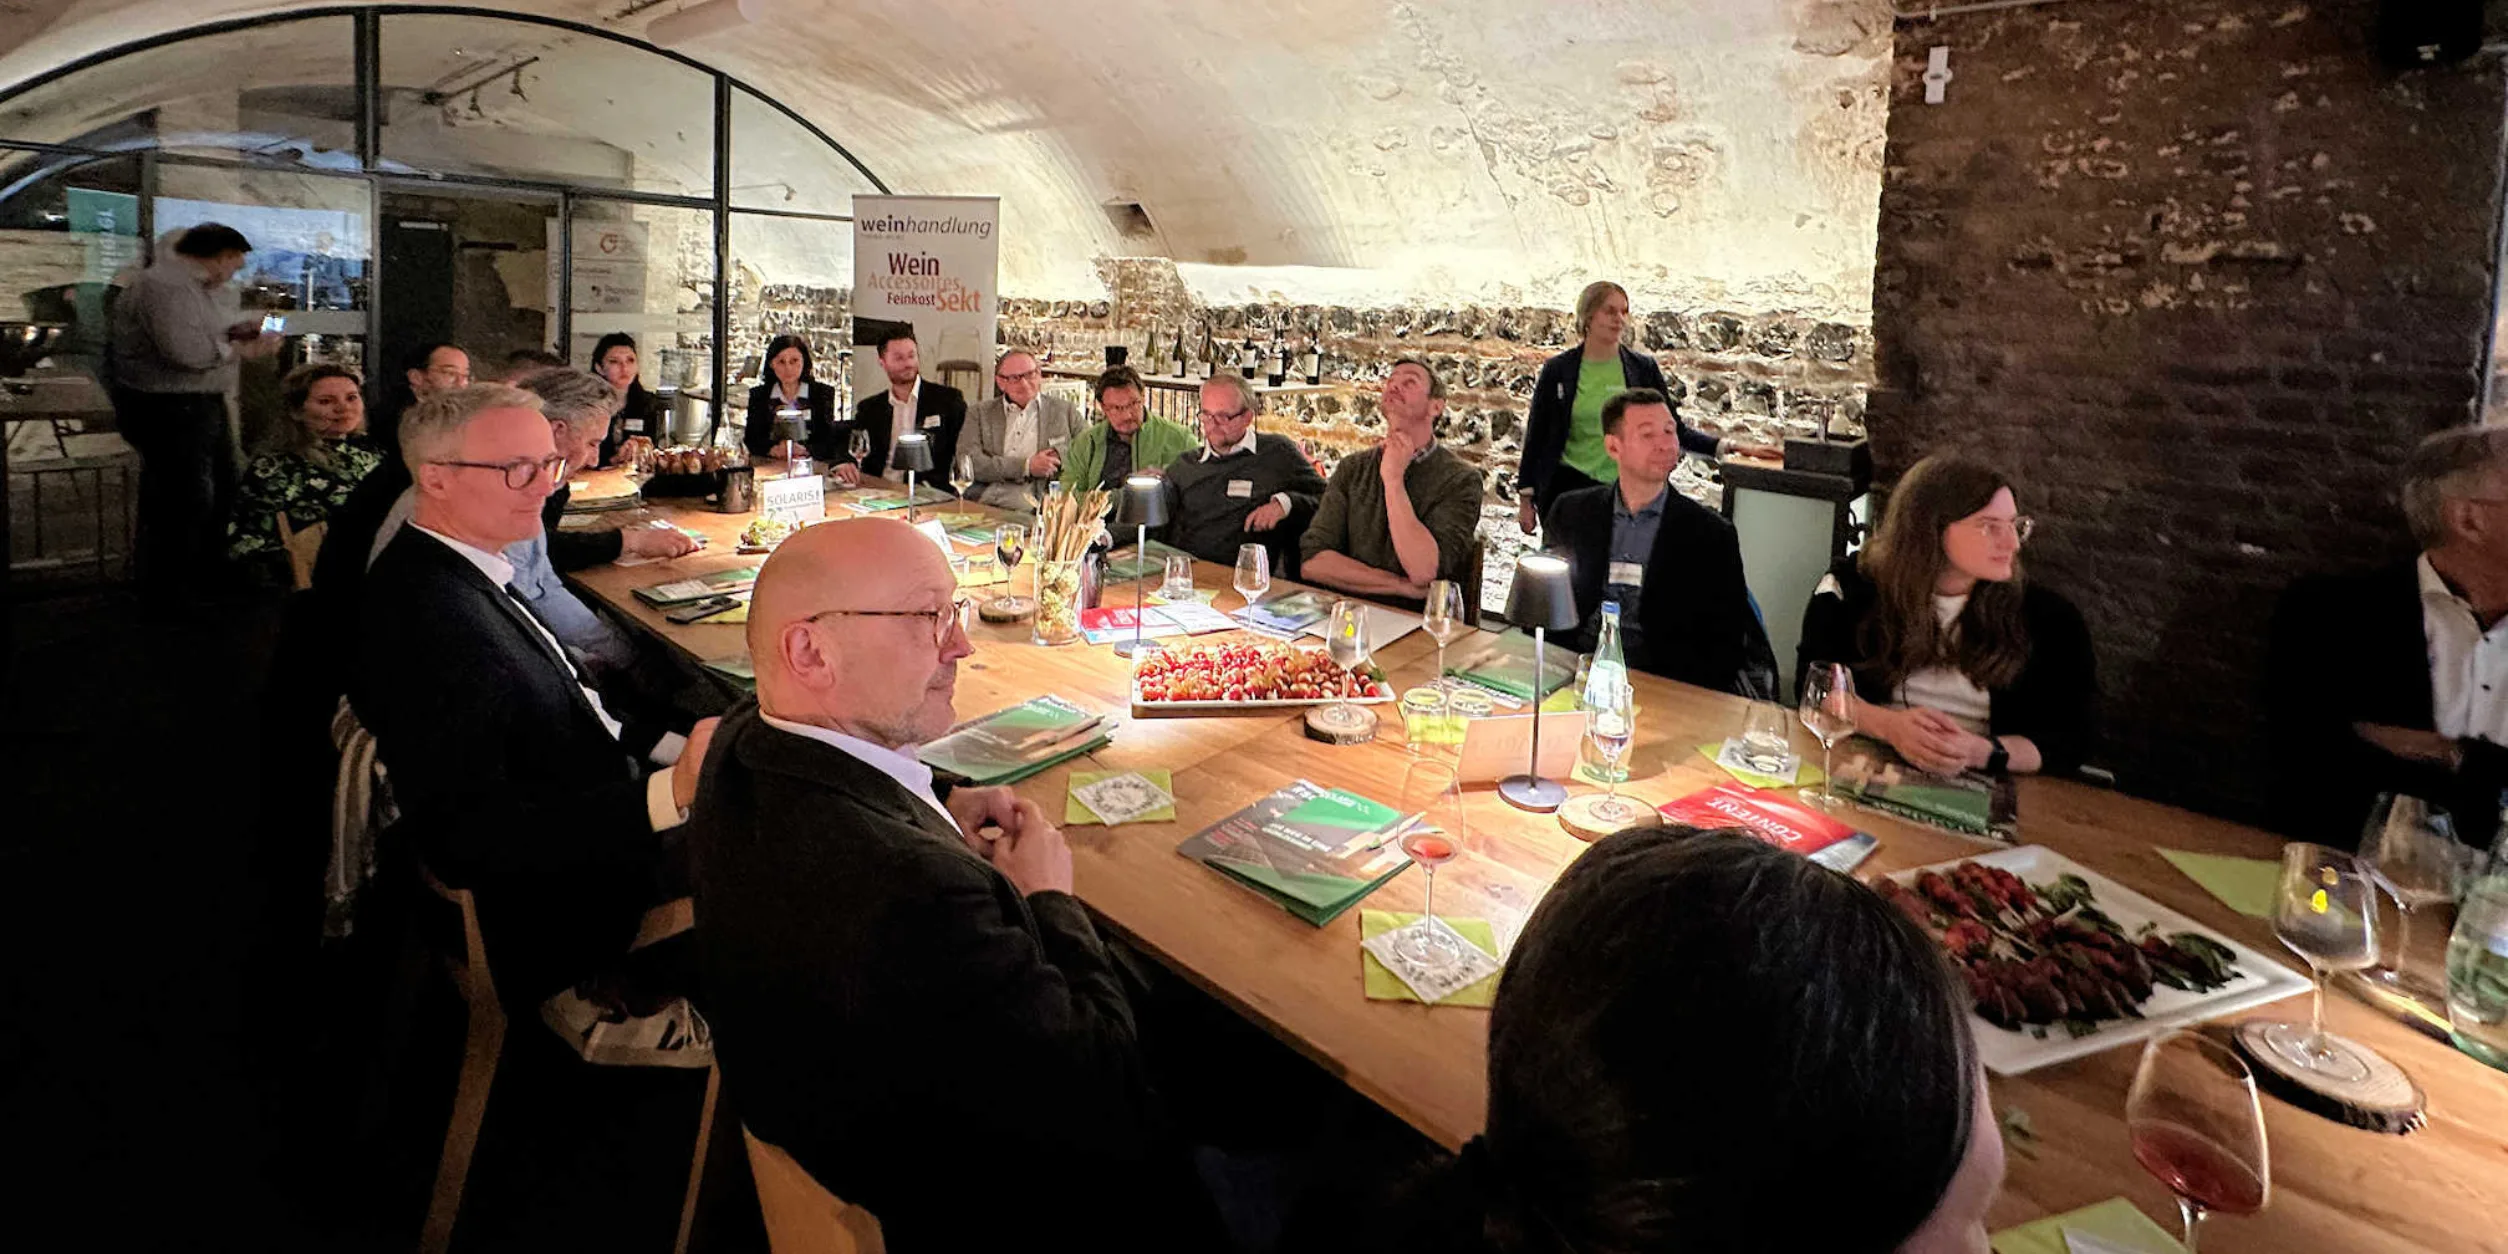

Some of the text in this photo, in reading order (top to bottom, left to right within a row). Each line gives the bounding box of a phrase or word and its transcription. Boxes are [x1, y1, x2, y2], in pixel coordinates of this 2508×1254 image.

[861, 214, 992, 239] weinhandlung
[888, 251, 940, 276] Wein
[867, 271, 961, 291] Accessoires
[887, 291, 936, 306] Feinkost
[935, 286, 981, 313] Sekt
[1706, 797, 1803, 842] CONTENT
